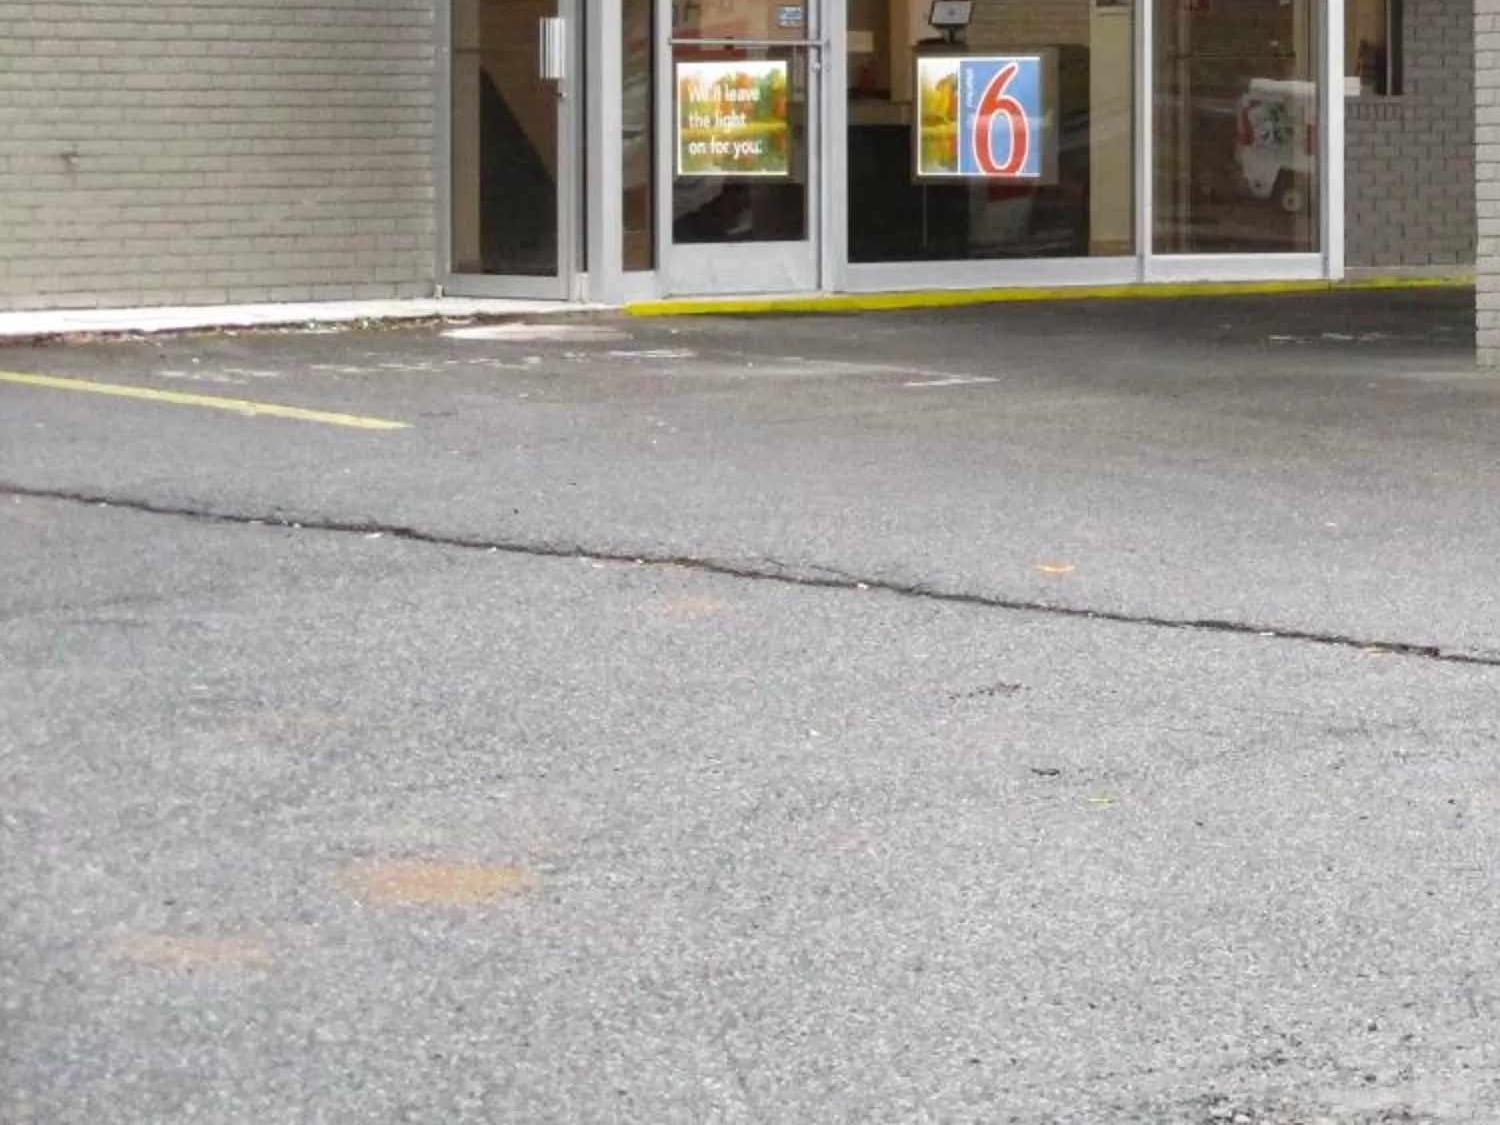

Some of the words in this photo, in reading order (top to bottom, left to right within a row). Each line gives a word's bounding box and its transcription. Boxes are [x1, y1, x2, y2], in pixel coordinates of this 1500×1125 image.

[724, 81, 761, 102] leave
[688, 111, 711, 128] the
[715, 109, 746, 134] light
[972, 61, 1029, 176] 6
[688, 141, 707, 156] on
[709, 134, 730, 155] for
